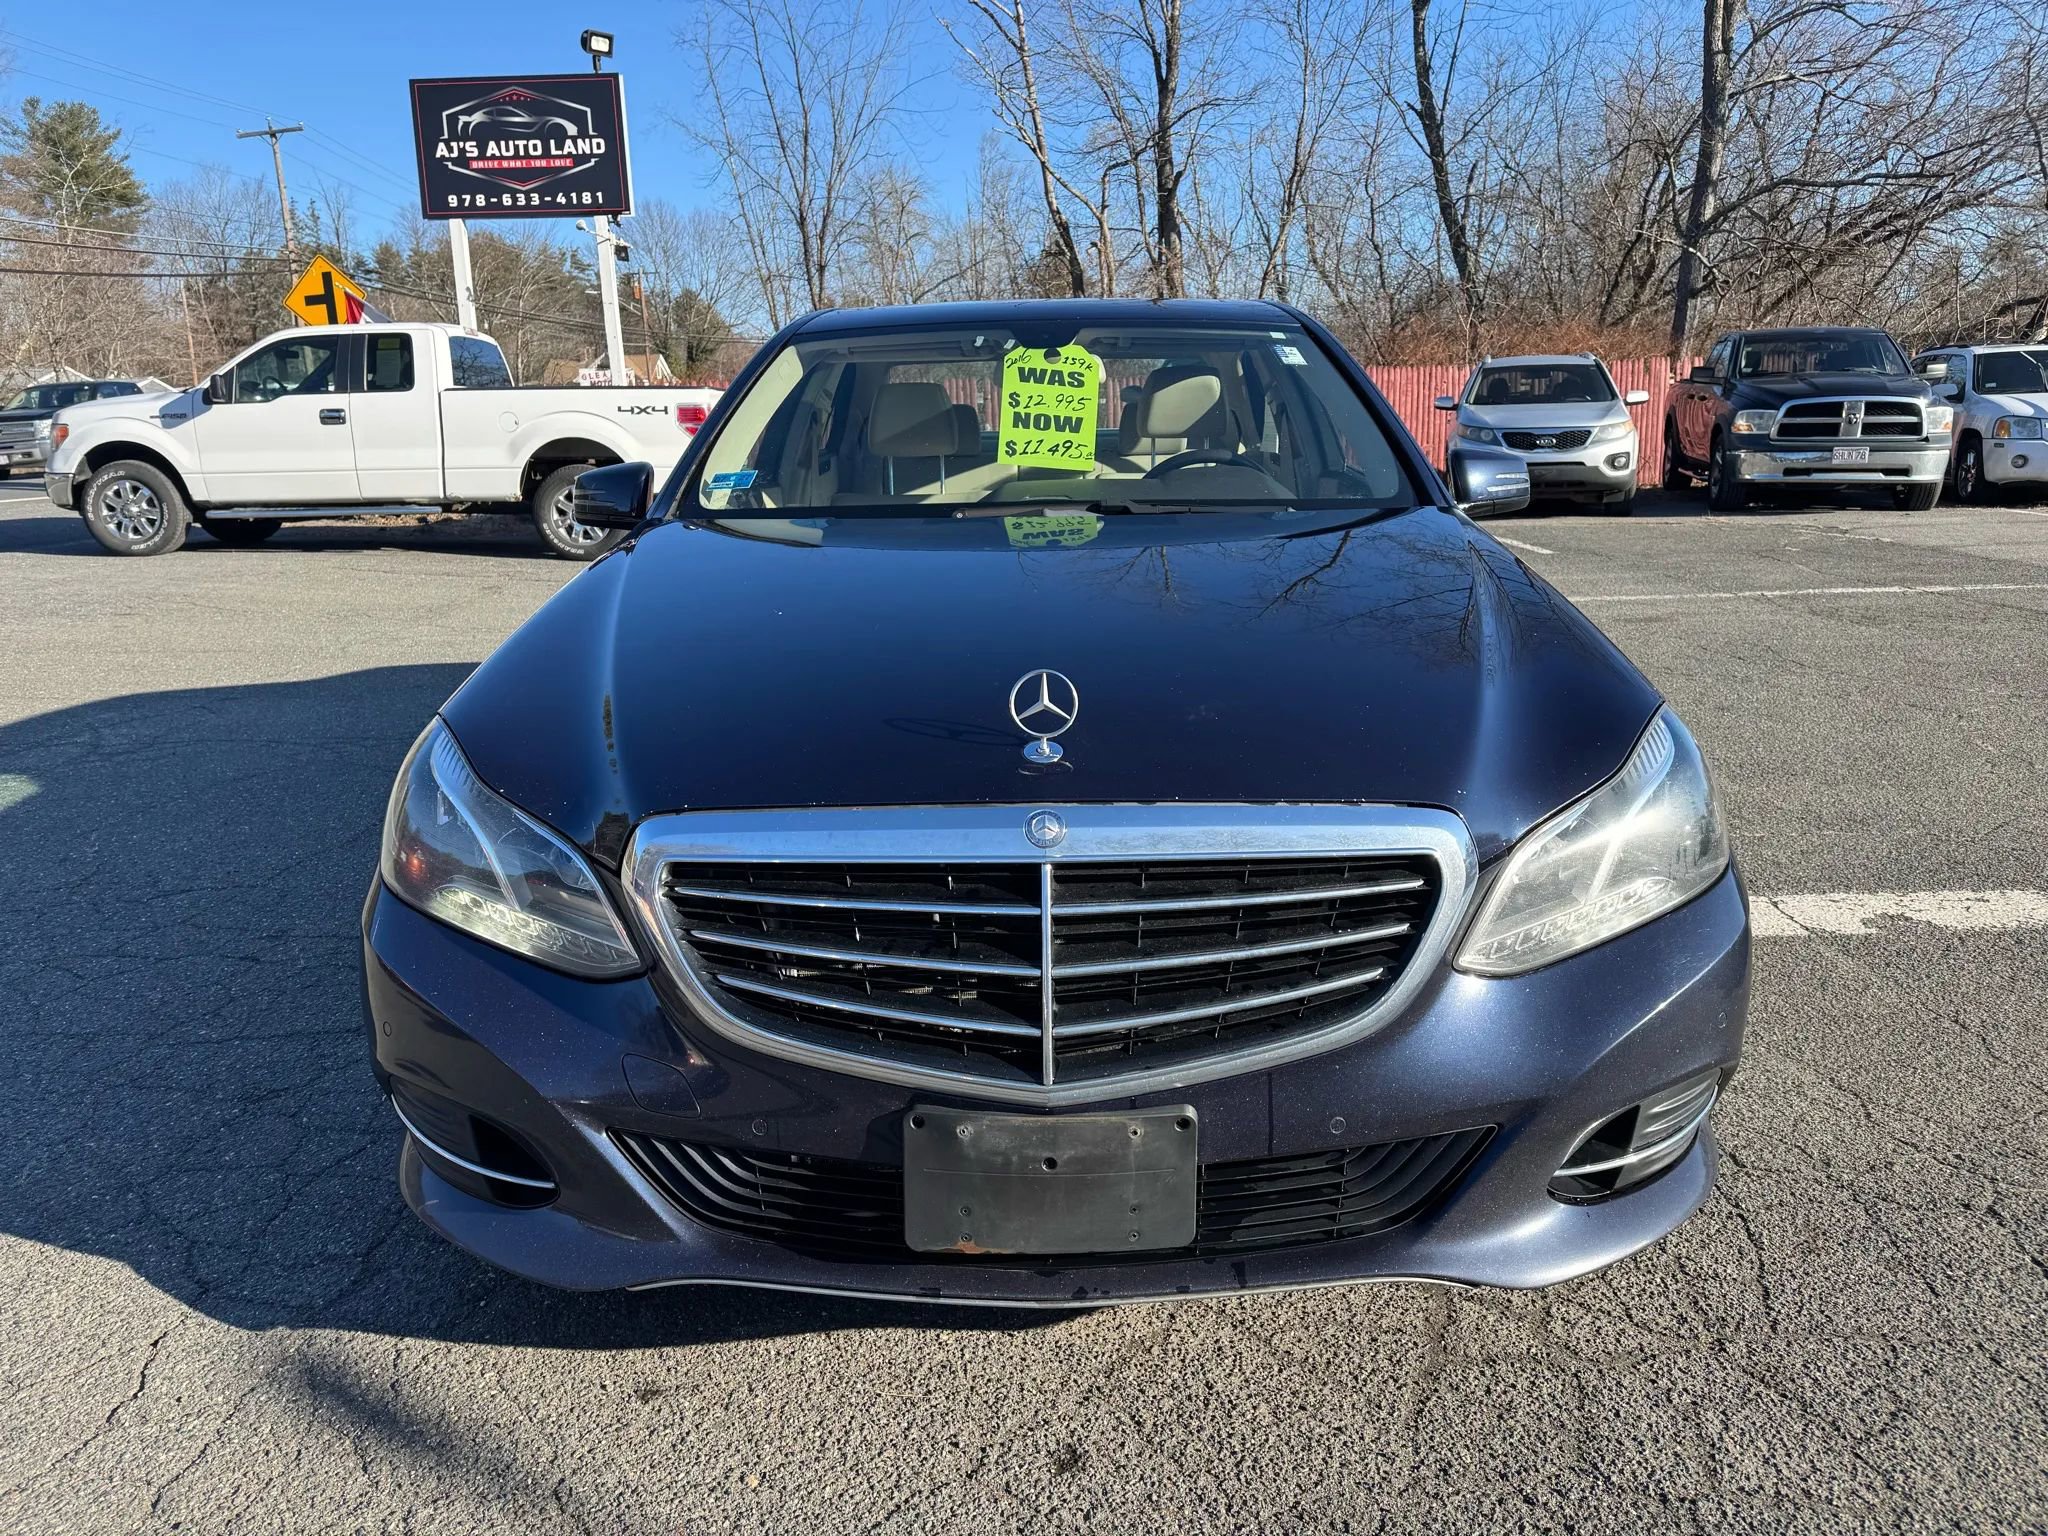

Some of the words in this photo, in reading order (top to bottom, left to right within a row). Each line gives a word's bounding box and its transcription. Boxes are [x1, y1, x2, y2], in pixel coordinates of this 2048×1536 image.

[435, 141, 478, 158] AJ'S
[486, 139, 542, 157] AUTO
[550, 138, 606, 155] LAND
[472, 160, 498, 169] DRIVE
[501, 160, 526, 168] WHAT
[531, 159, 546, 167] YOU
[550, 159, 572, 167] LOVE
[448, 191, 603, 208] 978-633-4181
[1005, 348, 1032, 368] 2016
[581, 370, 632, 380] GLEAN
[1017, 367, 1085, 388] WAS
[617, 405, 669, 415] 4X4
[1012, 411, 1084, 434] NOW
